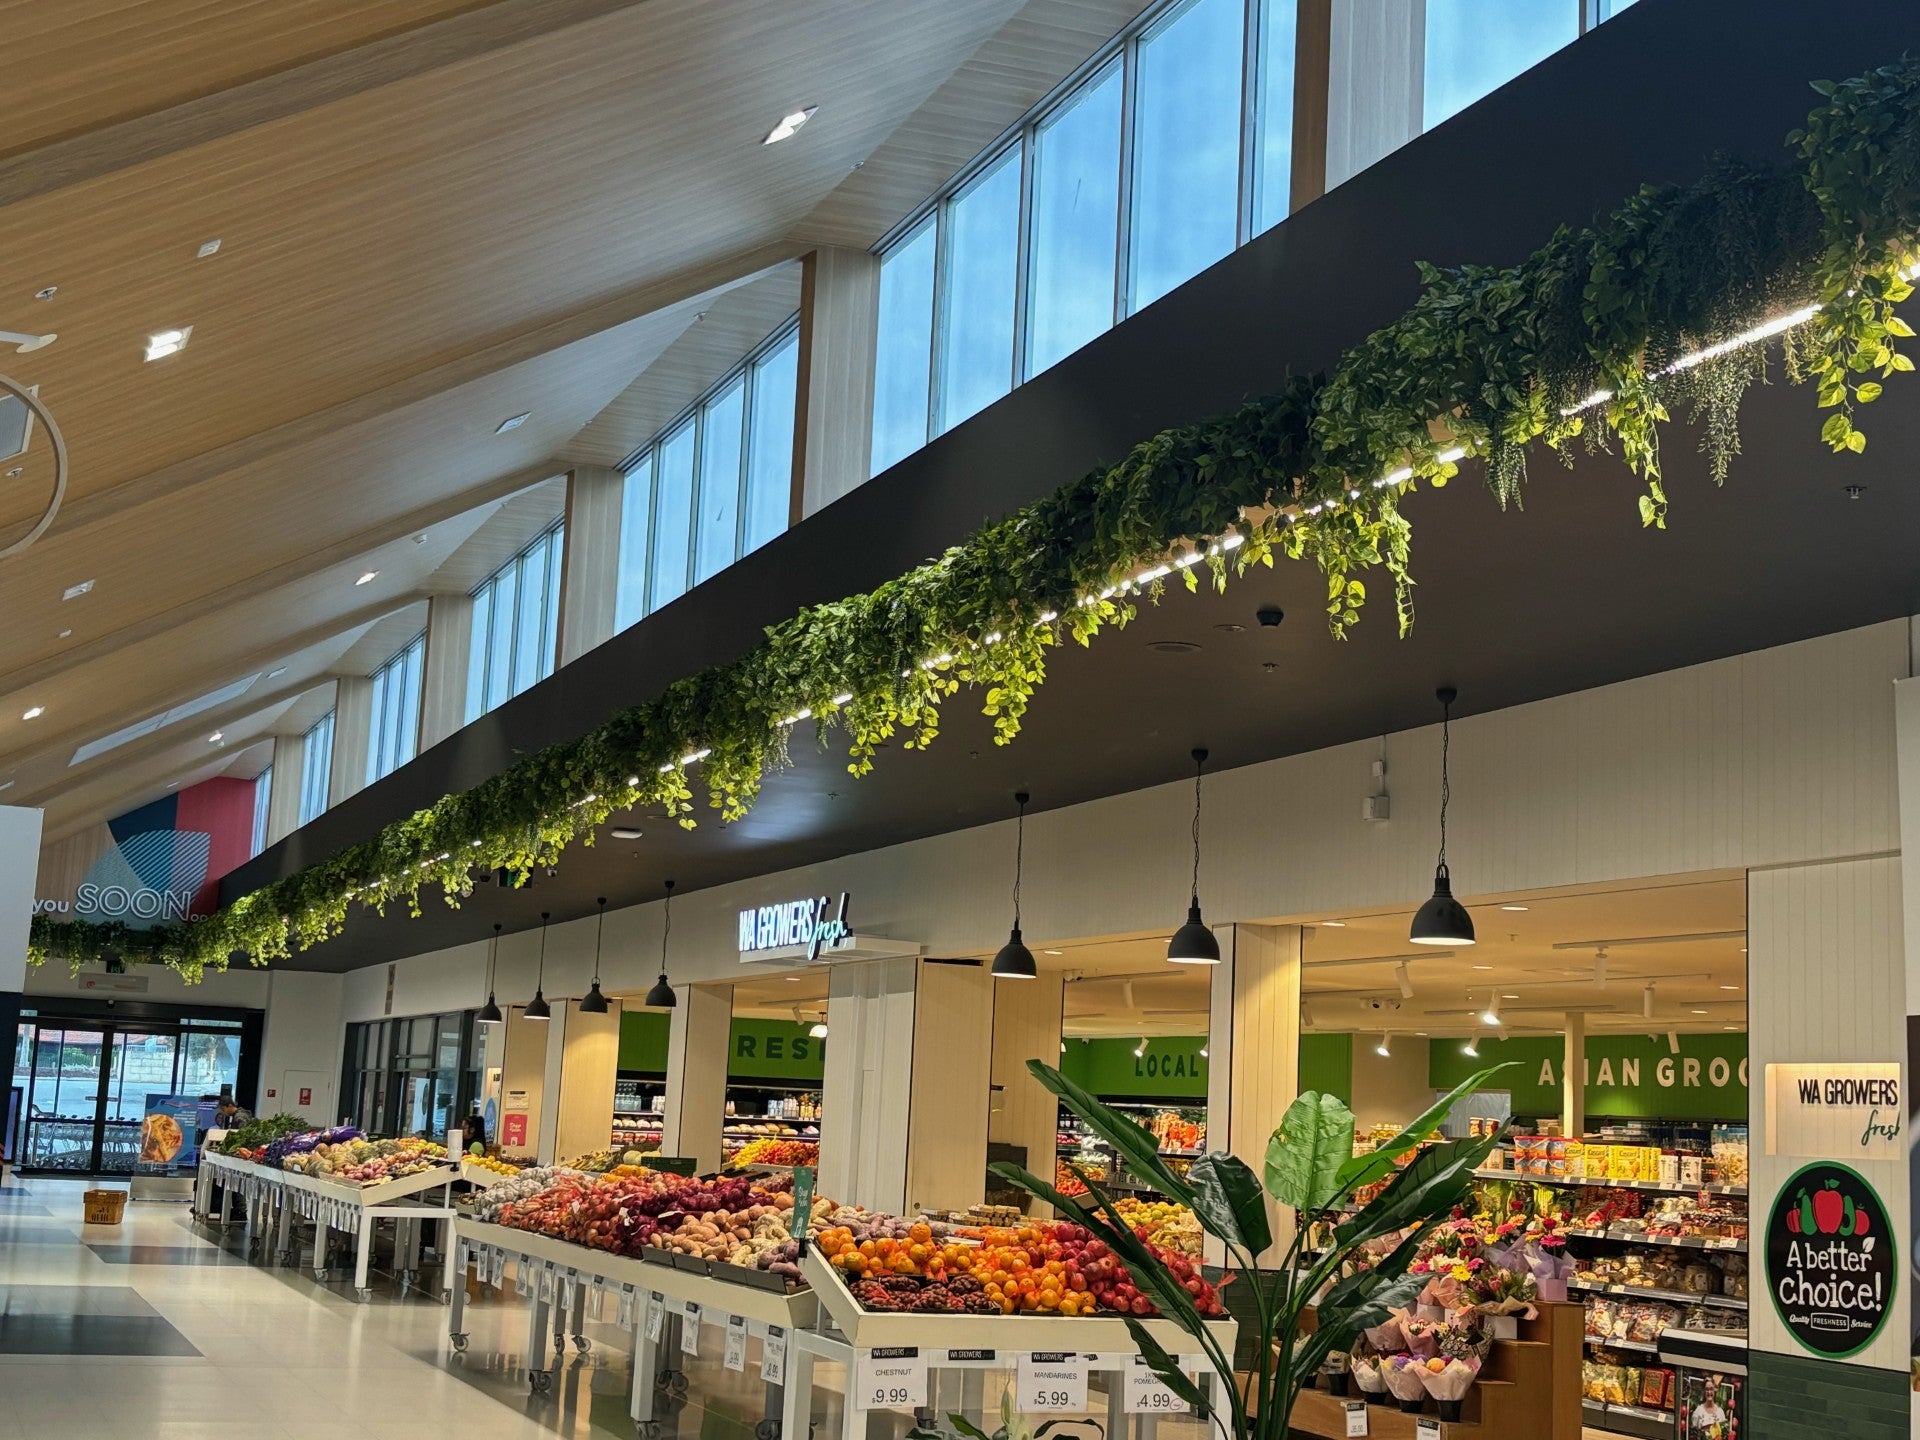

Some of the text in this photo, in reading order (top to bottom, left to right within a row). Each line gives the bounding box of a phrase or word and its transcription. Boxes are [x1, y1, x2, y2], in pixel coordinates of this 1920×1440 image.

[32, 899, 69, 914] you
[739, 892, 847, 960] WA GROWERS fresh
[1135, 1054, 1199, 1077] LOCAL
[1537, 1058, 1640, 1086] AIAN
[1798, 1079, 1898, 1106] WA GROWERS
[1786, 1240, 1873, 1272] A better
[1779, 1269, 1882, 1312] choice!
[1789, 1313, 1873, 1329] Quality FRESHNESS Service
[881, 1348, 905, 1357] GROWERS
[958, 1350, 982, 1359] GROWERS
[1041, 1352, 1064, 1361] GROWERS
[875, 1368, 912, 1377] CHESTNUT
[1034, 1372, 1078, 1380] MANDARINES
